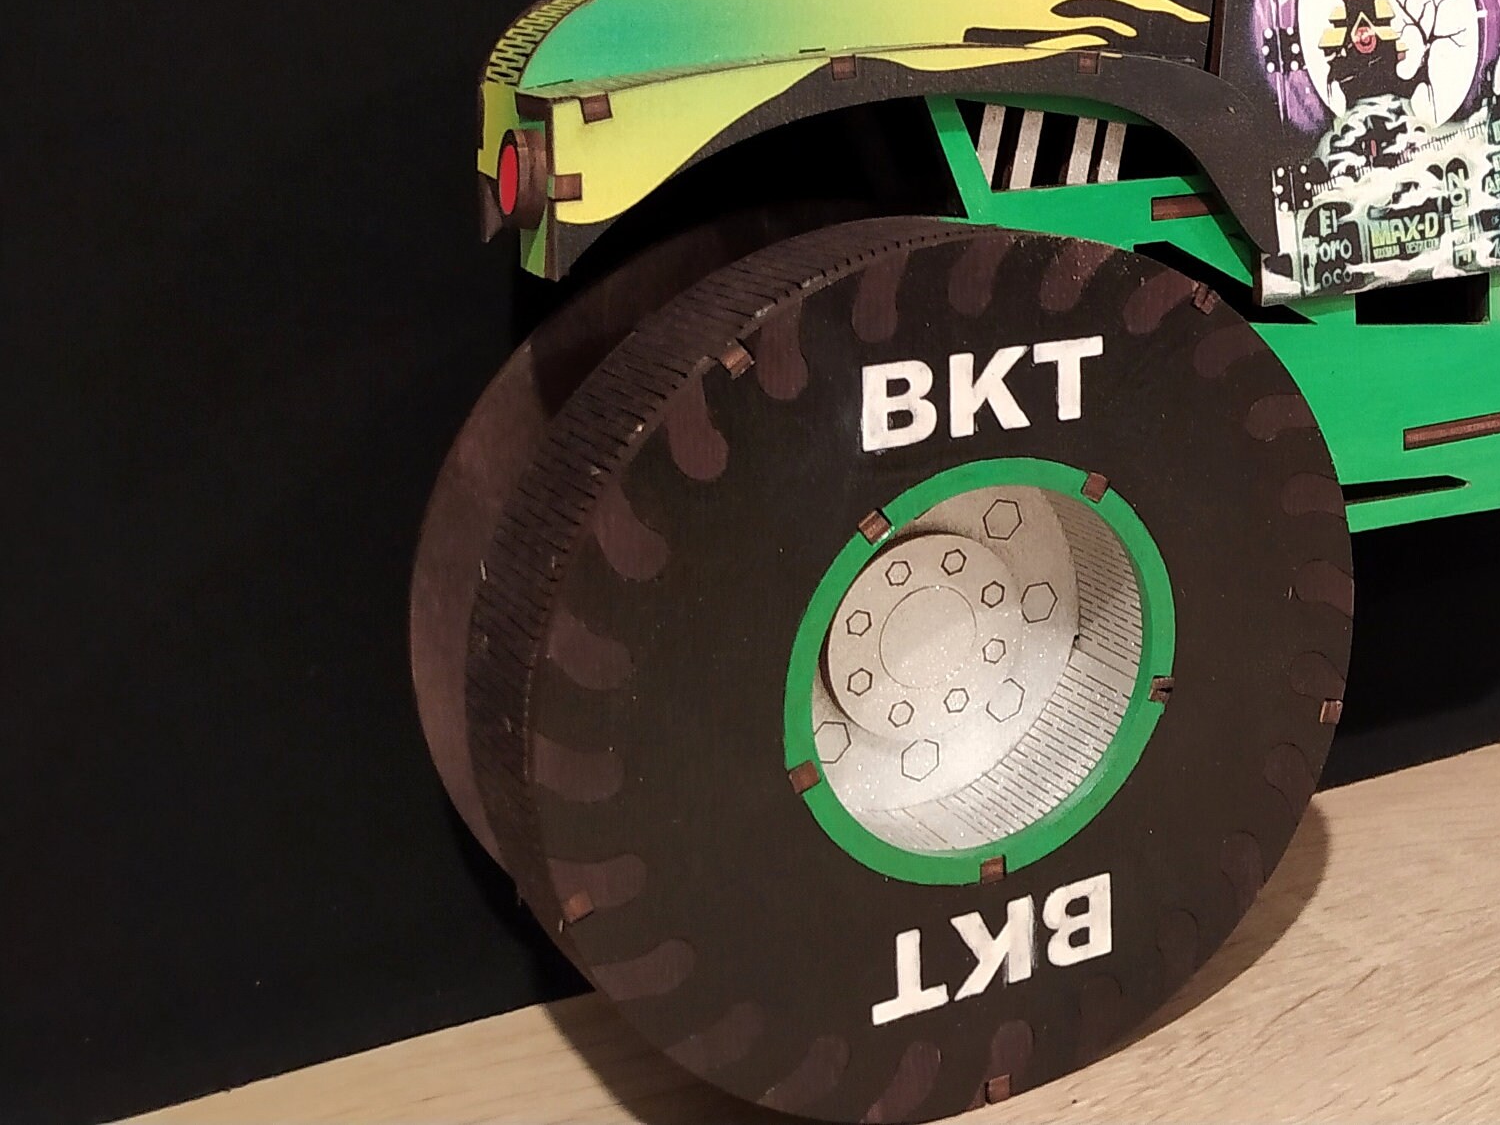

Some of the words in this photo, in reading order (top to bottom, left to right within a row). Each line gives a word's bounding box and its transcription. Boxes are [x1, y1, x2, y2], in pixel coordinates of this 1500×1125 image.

[1318, 207, 1339, 238] El
[1370, 211, 1440, 249] MAX-D
[1302, 235, 1353, 265] Toro
[1303, 262, 1353, 295] Loco
[862, 334, 1104, 453] BKT
[871, 871, 1113, 1026] BKT
